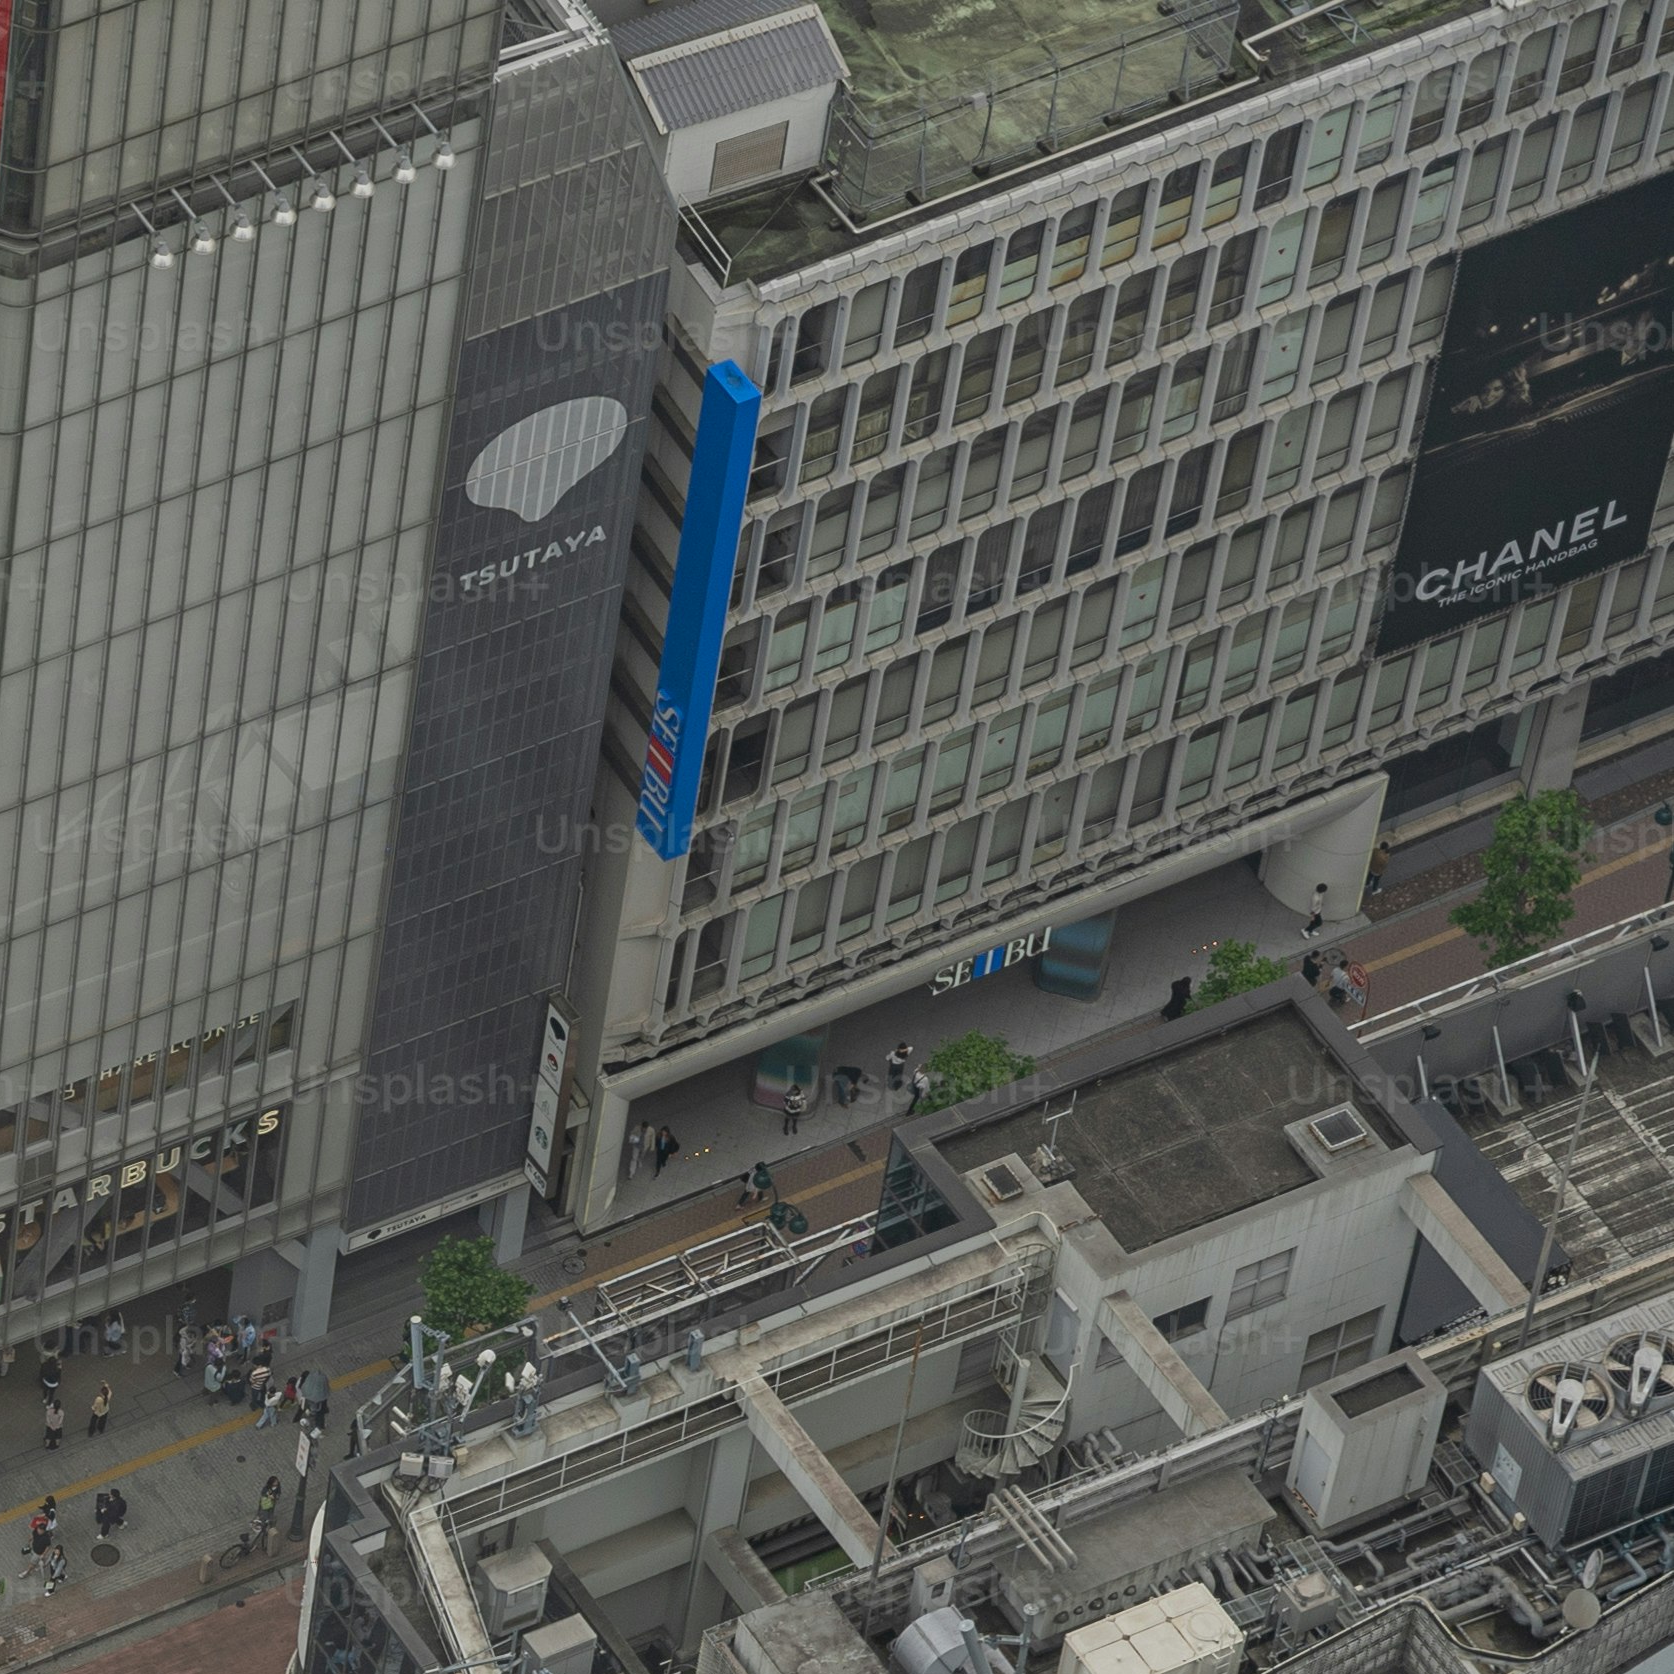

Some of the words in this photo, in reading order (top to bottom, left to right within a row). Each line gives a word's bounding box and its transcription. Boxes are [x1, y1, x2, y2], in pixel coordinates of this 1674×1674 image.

[460, 525, 607, 592] TSUTAYA
[1415, 499, 1628, 601] CHANEL
[1438, 590, 1468, 609] THE
[1470, 569, 1523, 597] ICONIC
[1525, 538, 1599, 575] HANDBAG
[931, 926, 1052, 997] SEIBU
[386, 1213, 427, 1234] TSUTAYA
